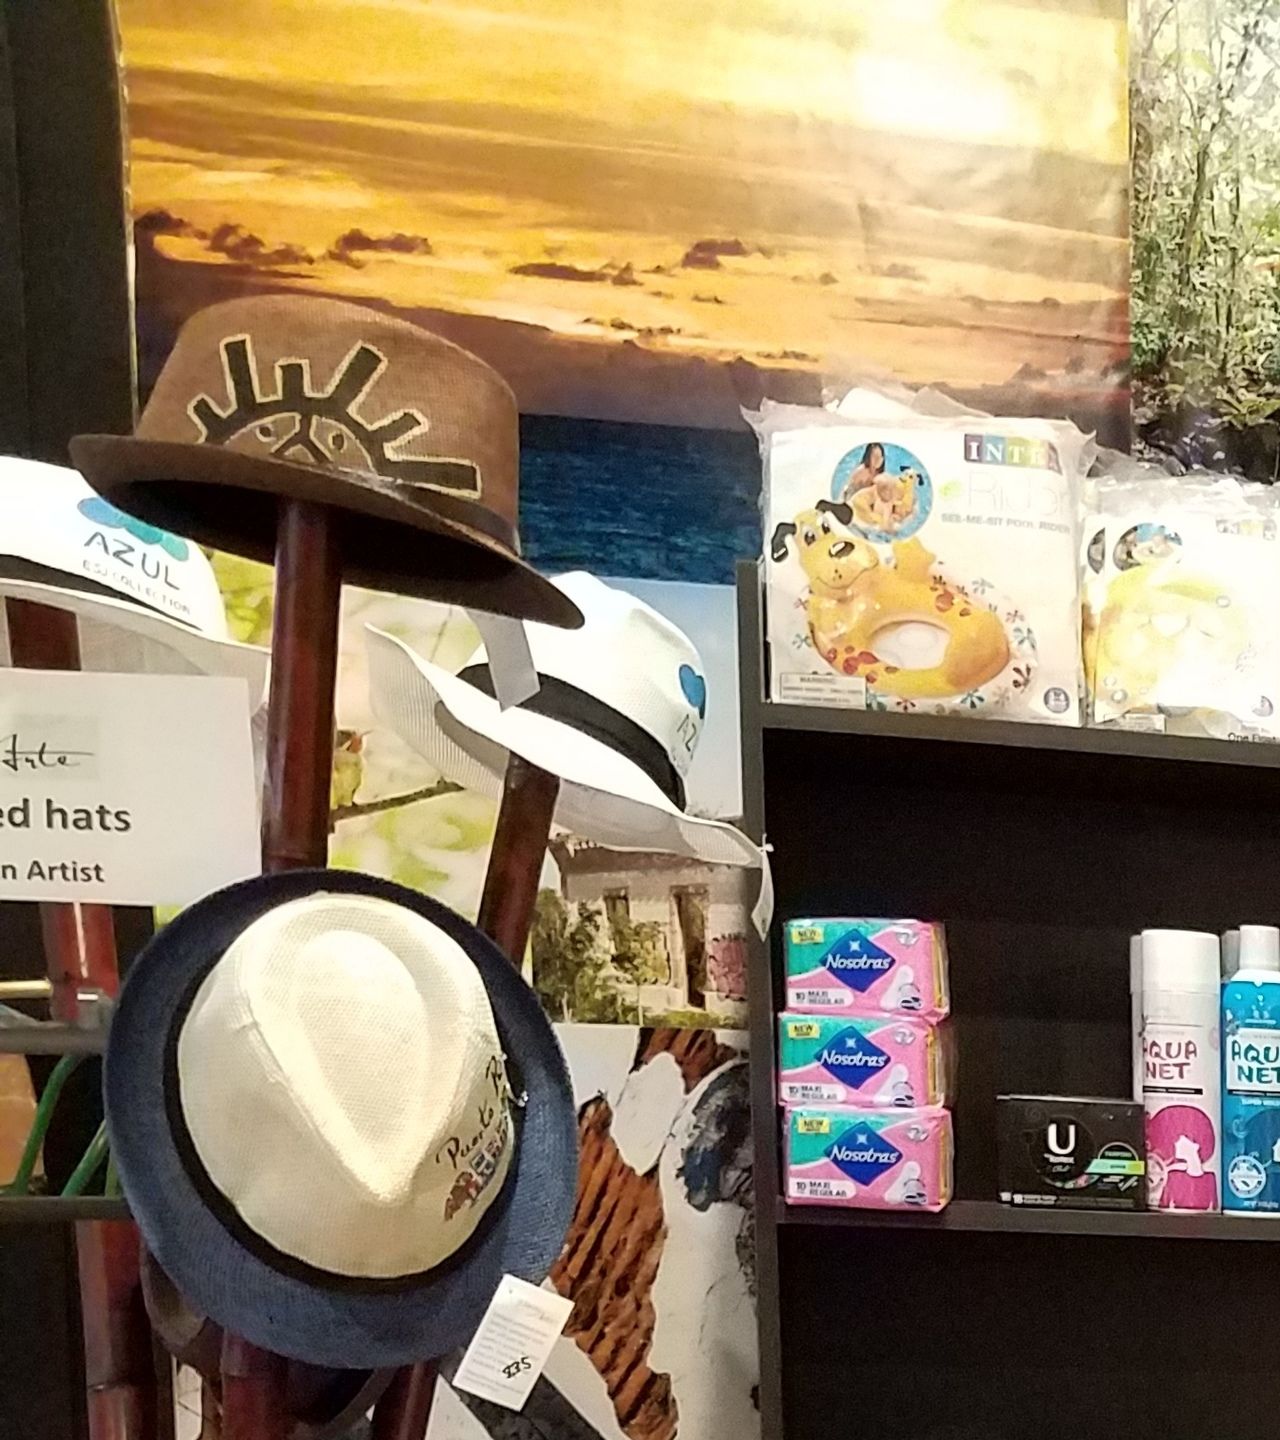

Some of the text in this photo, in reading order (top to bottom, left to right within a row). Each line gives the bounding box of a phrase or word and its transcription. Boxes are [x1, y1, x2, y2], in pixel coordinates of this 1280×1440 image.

[83, 530, 181, 592] AZUL
[46, 798, 132, 832] hats
[27, 860, 106, 883] Artist
[797, 930, 818, 939] NEW
[825, 953, 891, 970] Nosotras
[792, 1025, 814, 1034] NEW
[820, 1049, 887, 1068] Nosotras
[1145, 1062, 1191, 1081] NET
[803, 1119, 825, 1128] NEW
[435, 1104, 495, 1169] Puerto
[1047, 1122, 1077, 1155] U
[830, 1145, 900, 1164] Nosotras
[796, 1181, 831, 1191] 10 MAXI
